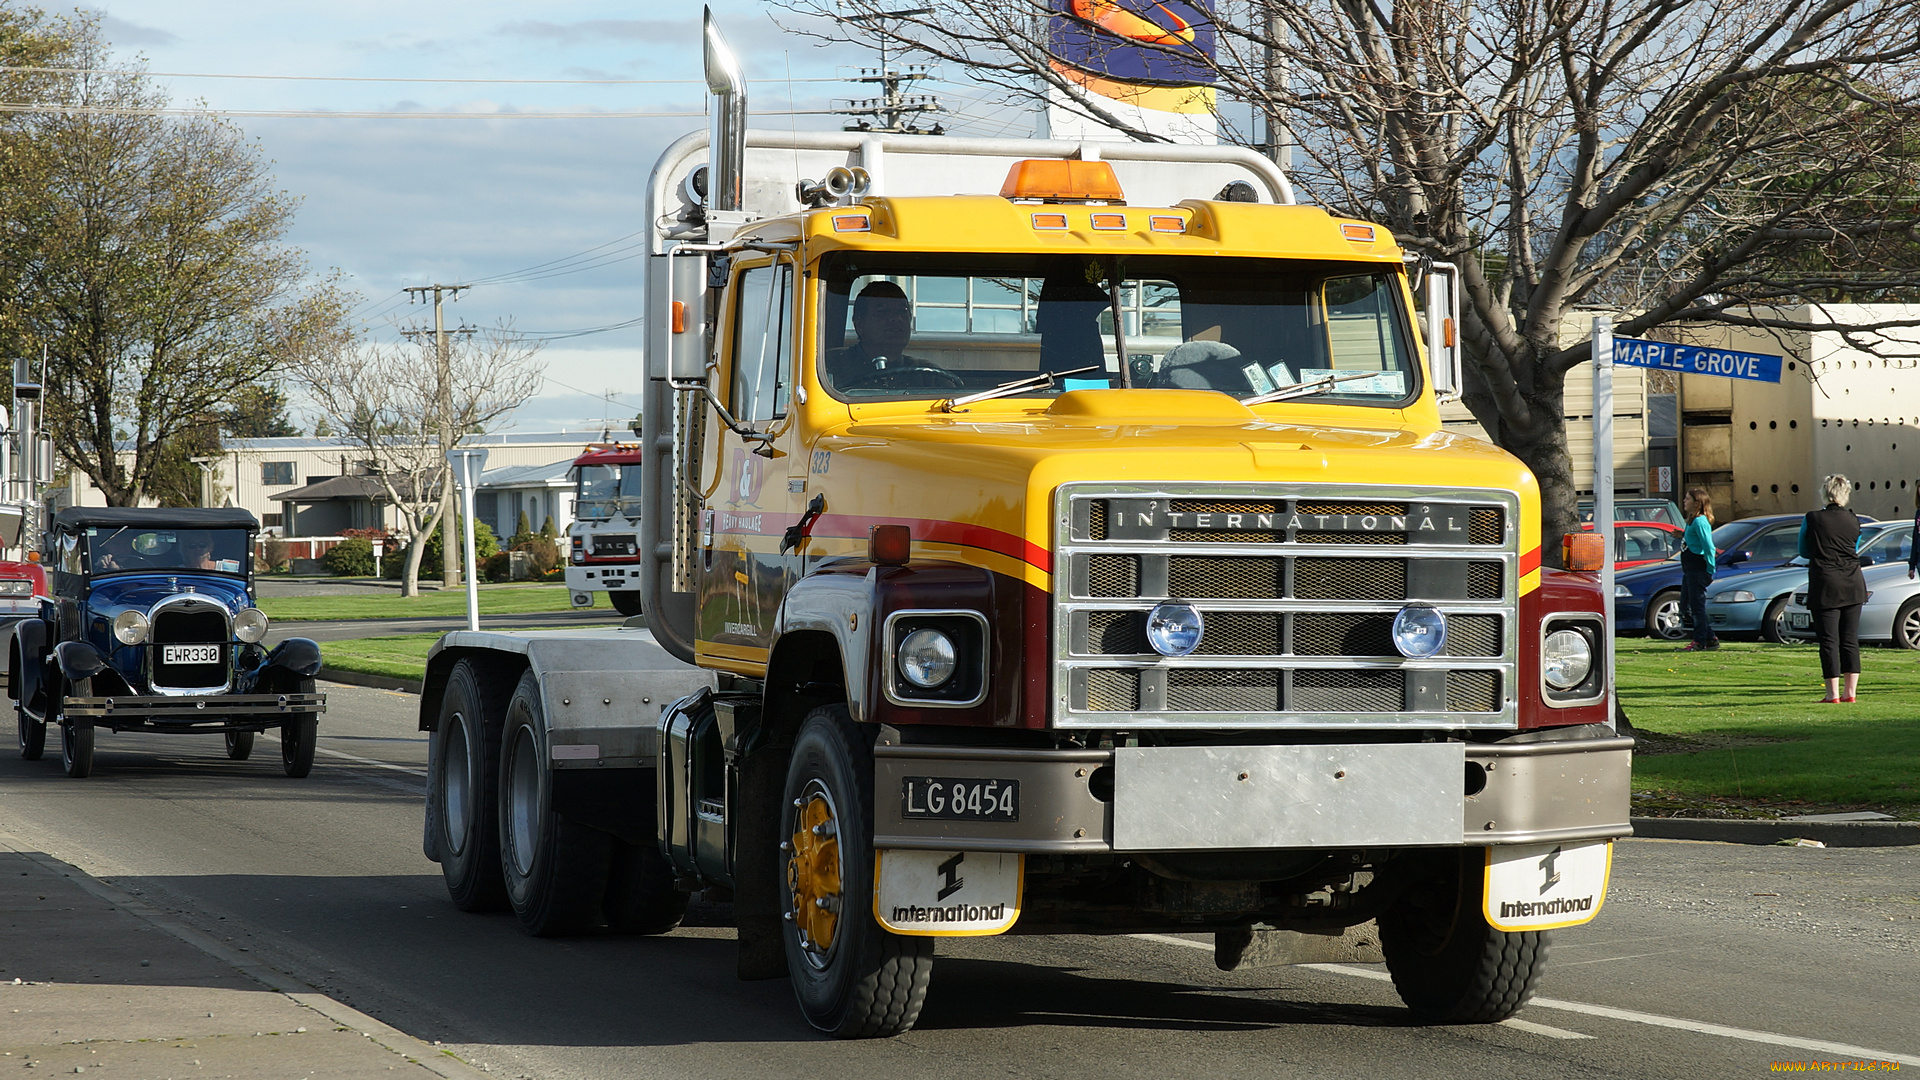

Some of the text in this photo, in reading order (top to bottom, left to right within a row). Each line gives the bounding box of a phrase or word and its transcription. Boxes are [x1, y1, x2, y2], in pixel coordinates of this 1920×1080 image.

[1614, 341, 1760, 377] MAPLE GROVE
[811, 451, 831, 474] 323
[722, 513, 762, 532] HEAVY HAULAGE
[1116, 511, 1462, 531] INTERNATIONAL
[166, 648, 217, 662] EWR330
[908, 782, 1014, 816] LG 8454
[892, 903, 1005, 922] International
[1500, 895, 1593, 918] International
